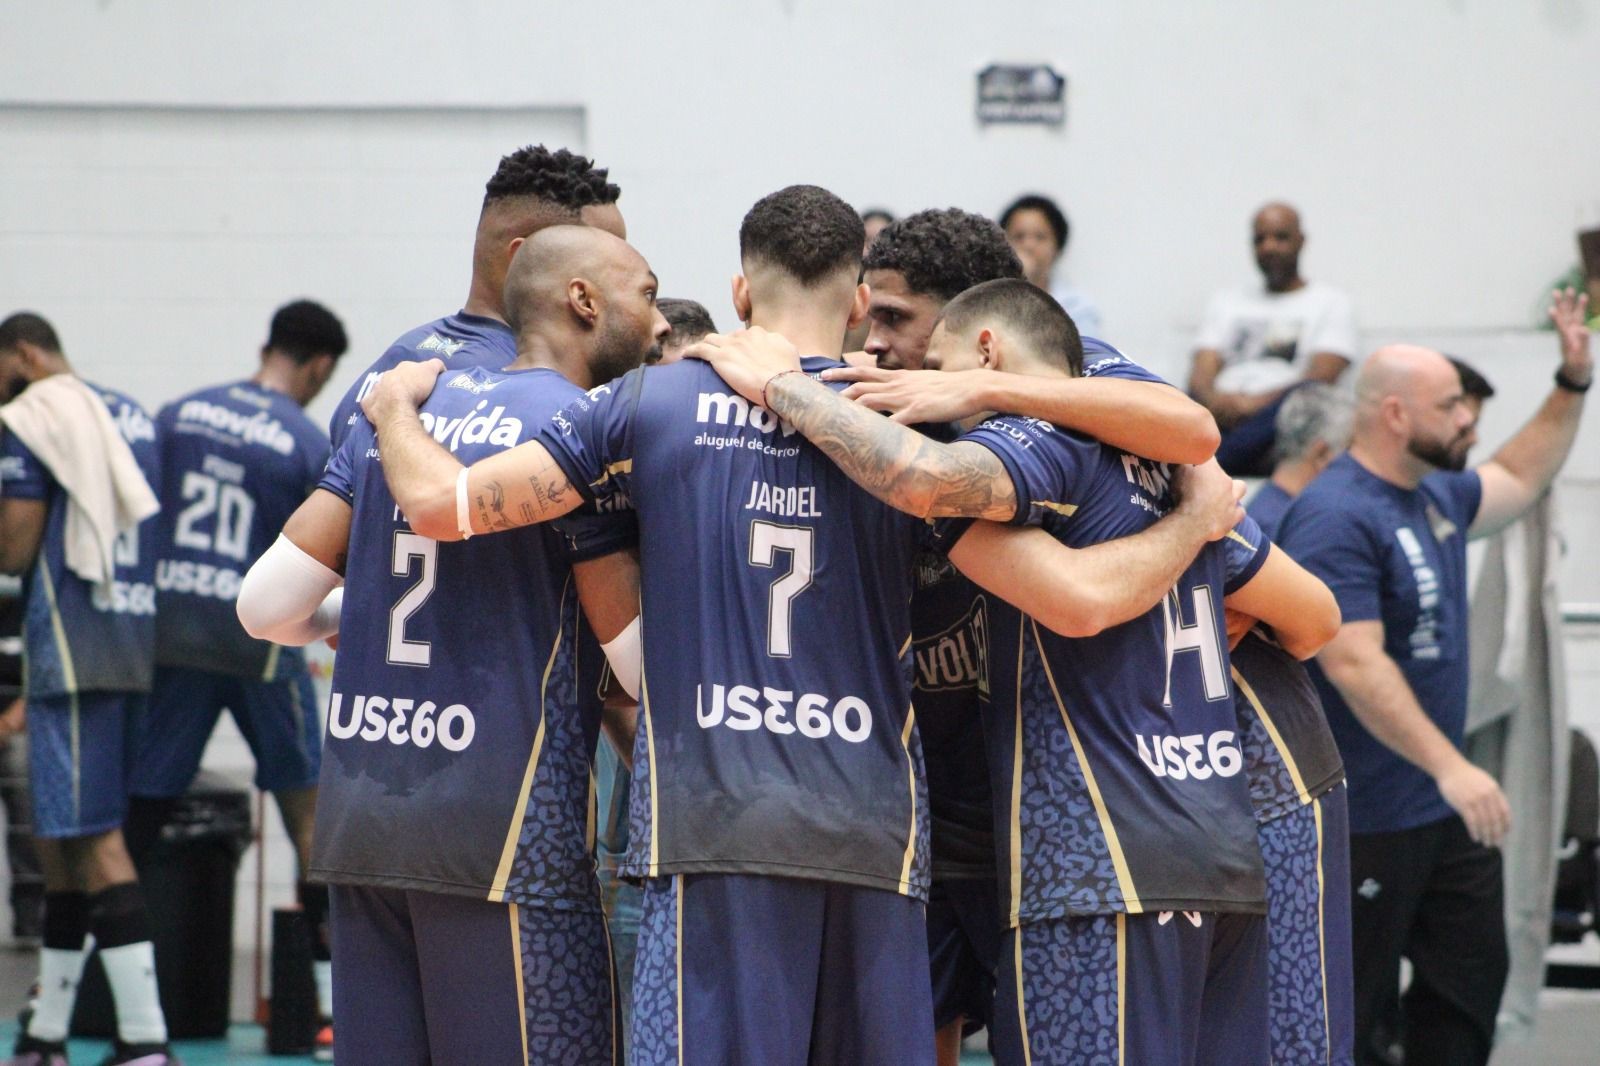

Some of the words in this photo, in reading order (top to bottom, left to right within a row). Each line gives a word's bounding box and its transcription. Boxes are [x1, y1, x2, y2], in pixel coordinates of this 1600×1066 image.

[178, 400, 295, 456] movida
[419, 400, 523, 452] ovida
[694, 432, 744, 450] aluguel
[747, 439, 763, 450] de
[174, 472, 256, 561] 20
[745, 481, 822, 517] JARDEL
[155, 559, 247, 601] USE6
[386, 529, 440, 668] 2
[749, 519, 814, 658] 7
[1135, 730, 1244, 780] USE6
